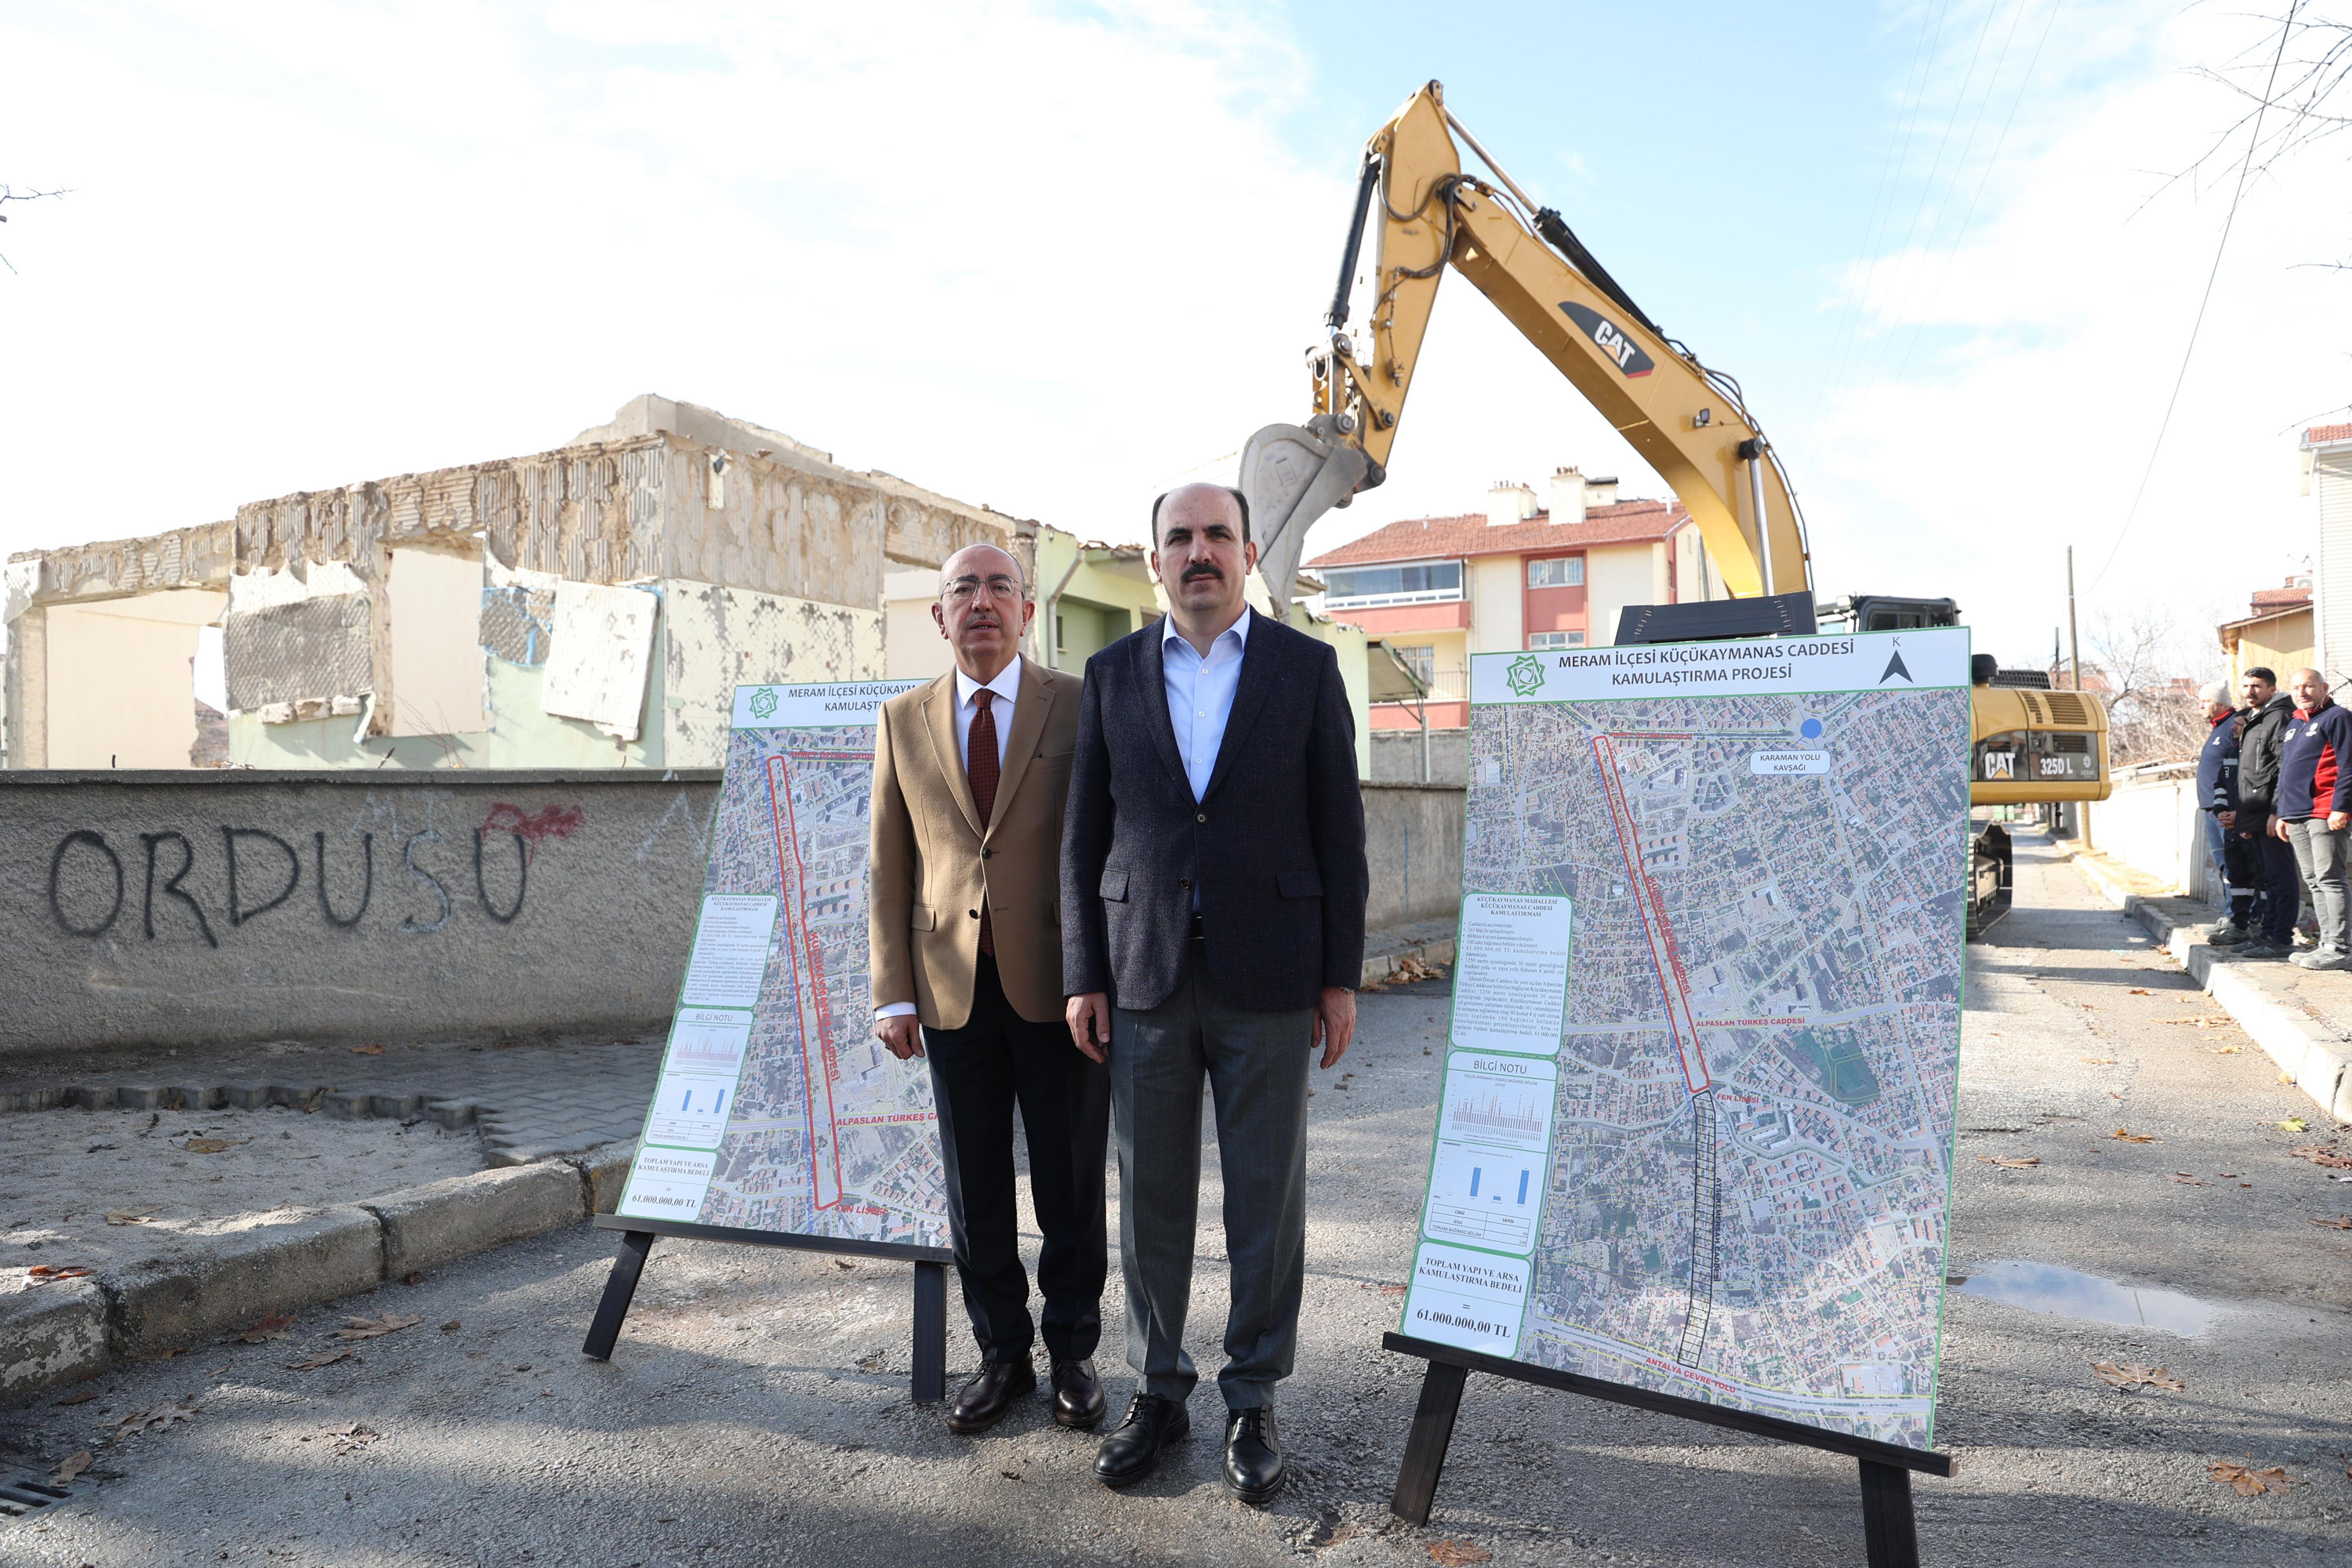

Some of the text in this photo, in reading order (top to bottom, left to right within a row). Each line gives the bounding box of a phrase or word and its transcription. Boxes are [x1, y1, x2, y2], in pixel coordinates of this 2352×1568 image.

[1595, 320, 1635, 368] CAT
[1892, 637, 1900, 647] K
[1559, 638, 1853, 668] MERAM İLÇESİ KÜÇÜKAYMANAS CADDESİ
[1612, 663, 1791, 685] KAMULAŞTIRMA PROJESİ
[789, 688, 825, 698] MERAM
[828, 685, 857, 699] İLÇESİ
[1774, 764, 1806, 772] KAVŞAĞI
[1984, 752, 2015, 779] CAT
[2040, 758, 2064, 775] 325D
[2067, 758, 2073, 774] L
[1473, 1058, 1527, 1075] BİLGİ NOTU
[837, 1116, 884, 1126] ALPASLAN
[887, 1112, 924, 1123] TÜRKEŞ
[638, 1165, 686, 1174] KAMULAŞTIRMA
[686, 1199, 697, 1208] TL
[835, 1204, 854, 1213] FEN
[1425, 1258, 1520, 1283] TOPLAM YAPI VE ARSA
[1418, 1267, 1523, 1294] KAMULAŞTIRMA BEDELİ
[1416, 1307, 1512, 1338] 61.000.000,00 TL
[1646, 1357, 1737, 1392] ANTALYA ÇEVRE YOLU
